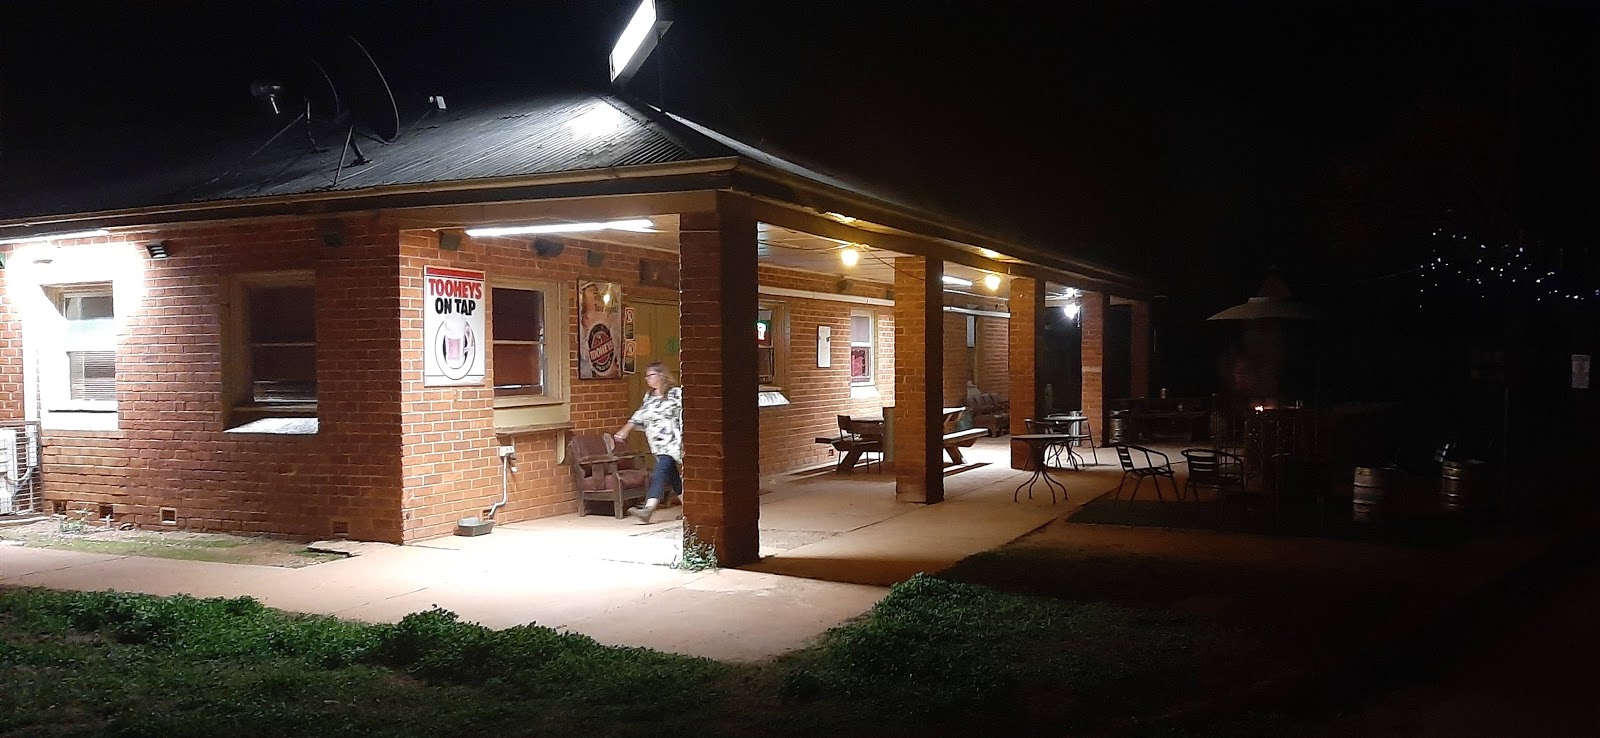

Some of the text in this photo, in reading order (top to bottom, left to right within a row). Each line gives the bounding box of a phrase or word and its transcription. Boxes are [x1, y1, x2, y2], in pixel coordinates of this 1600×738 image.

[428, 278, 482, 300] TOOHEYS
[435, 297, 476, 316] ON TAP
